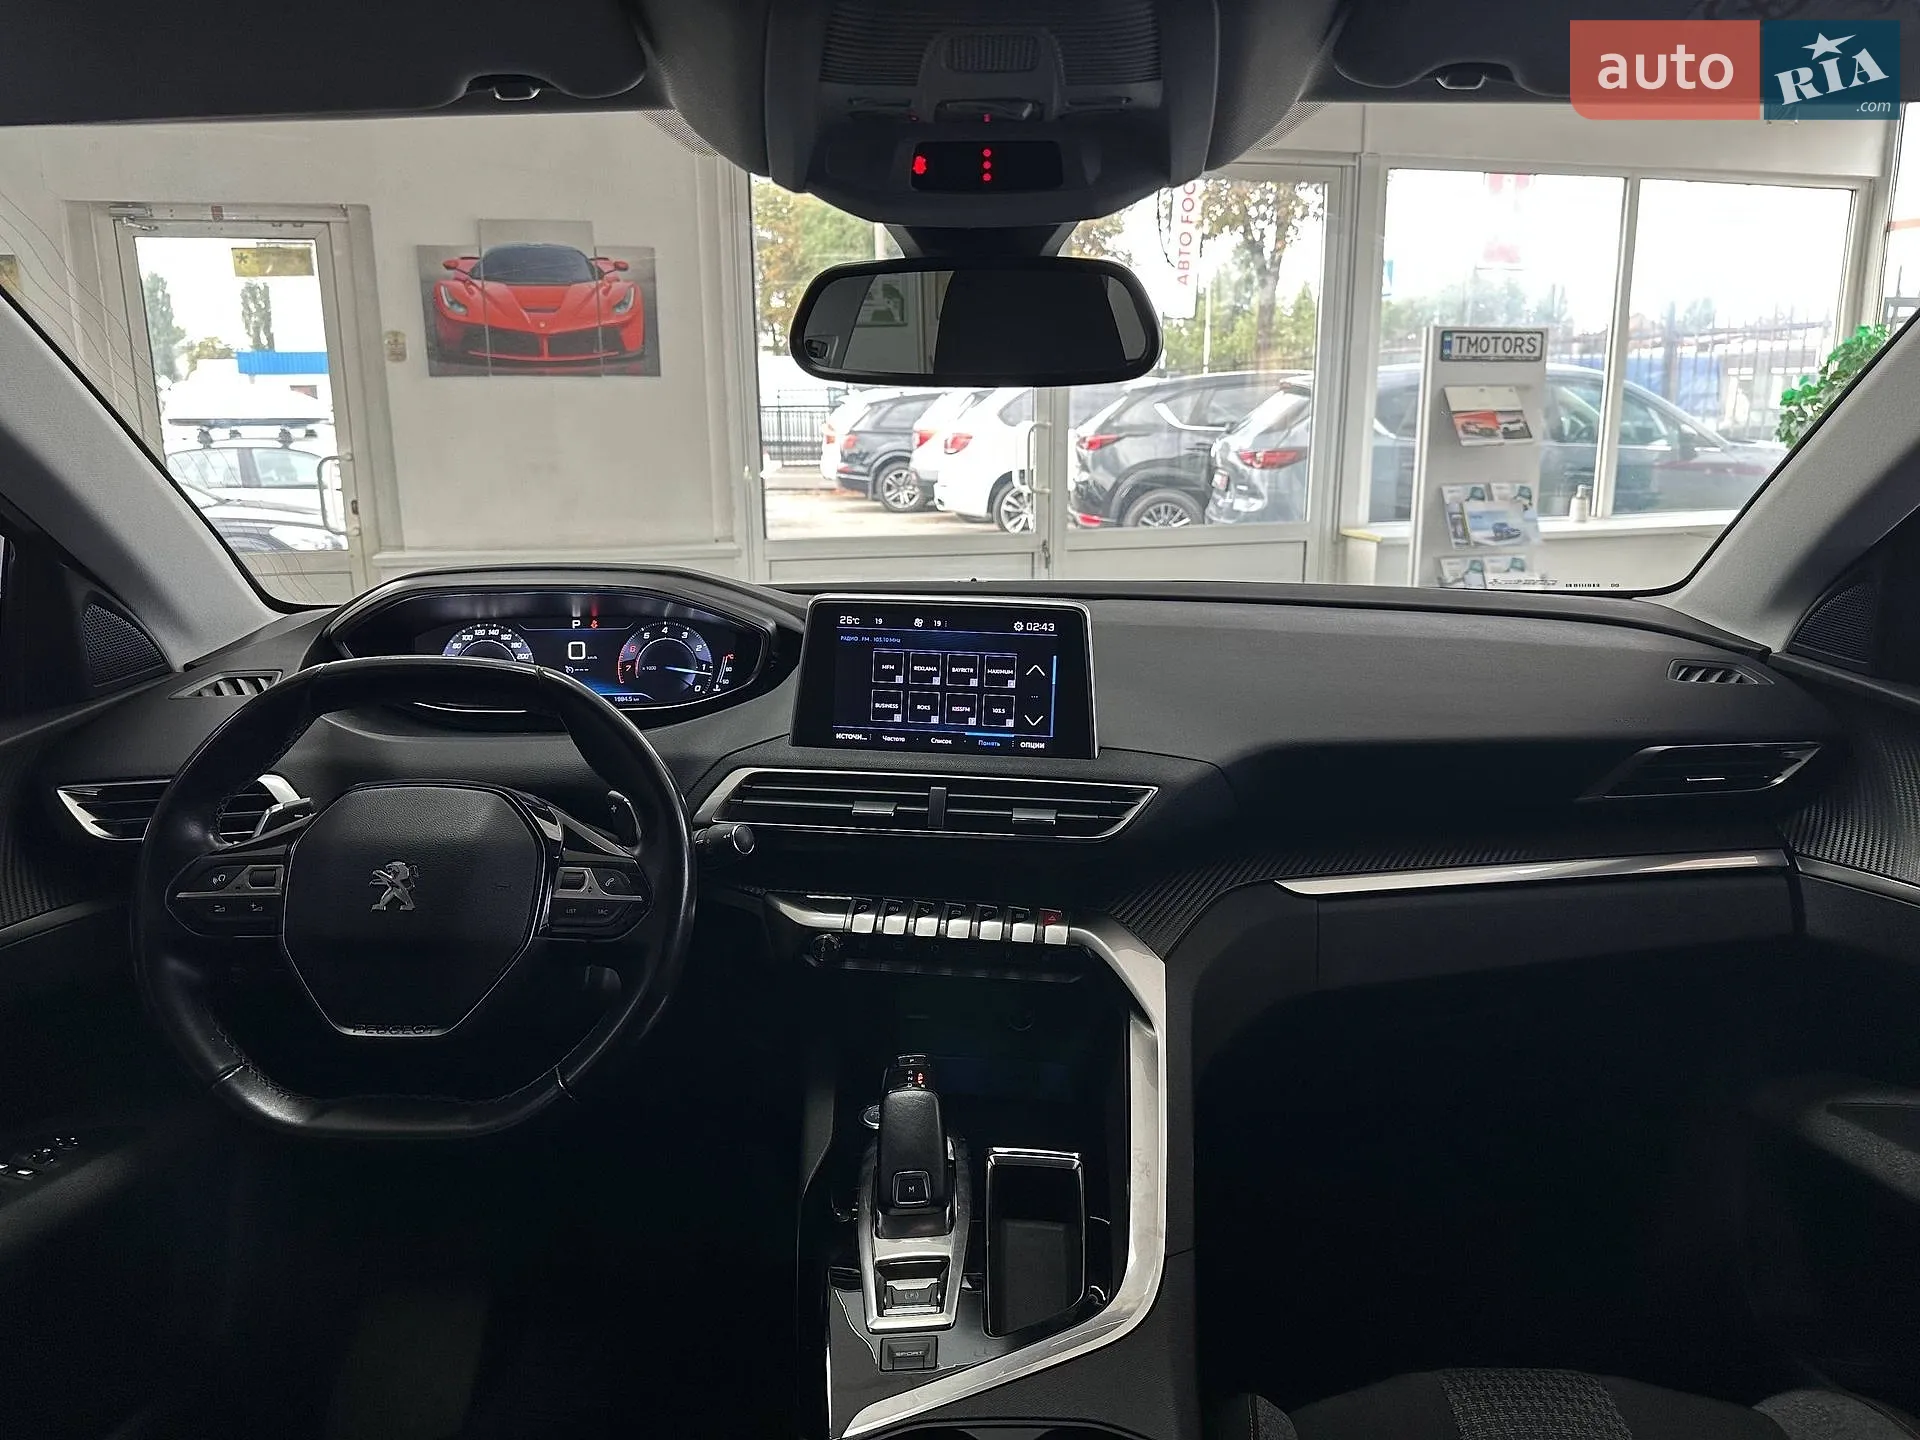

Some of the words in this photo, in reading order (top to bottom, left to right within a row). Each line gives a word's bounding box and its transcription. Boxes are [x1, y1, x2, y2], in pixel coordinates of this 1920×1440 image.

[1177, 231, 1193, 286] АВТО
[1455, 336, 1537, 354] TMOTORS
[571, 619, 581, 629] P
[1026, 622, 1055, 632] 02:43
[661, 626, 669, 634] 4
[643, 631, 651, 639] 5
[681, 631, 689, 639] 3
[567, 641, 586, 660] 0
[695, 644, 703, 652] 2
[625, 664, 632, 672] 7
[701, 663, 706, 671] 1
[930, 737, 952, 745] Список
[978, 739, 1001, 747] Память
[1020, 741, 1046, 749] ОПЦИИ
[908, 1185, 915, 1193] M
